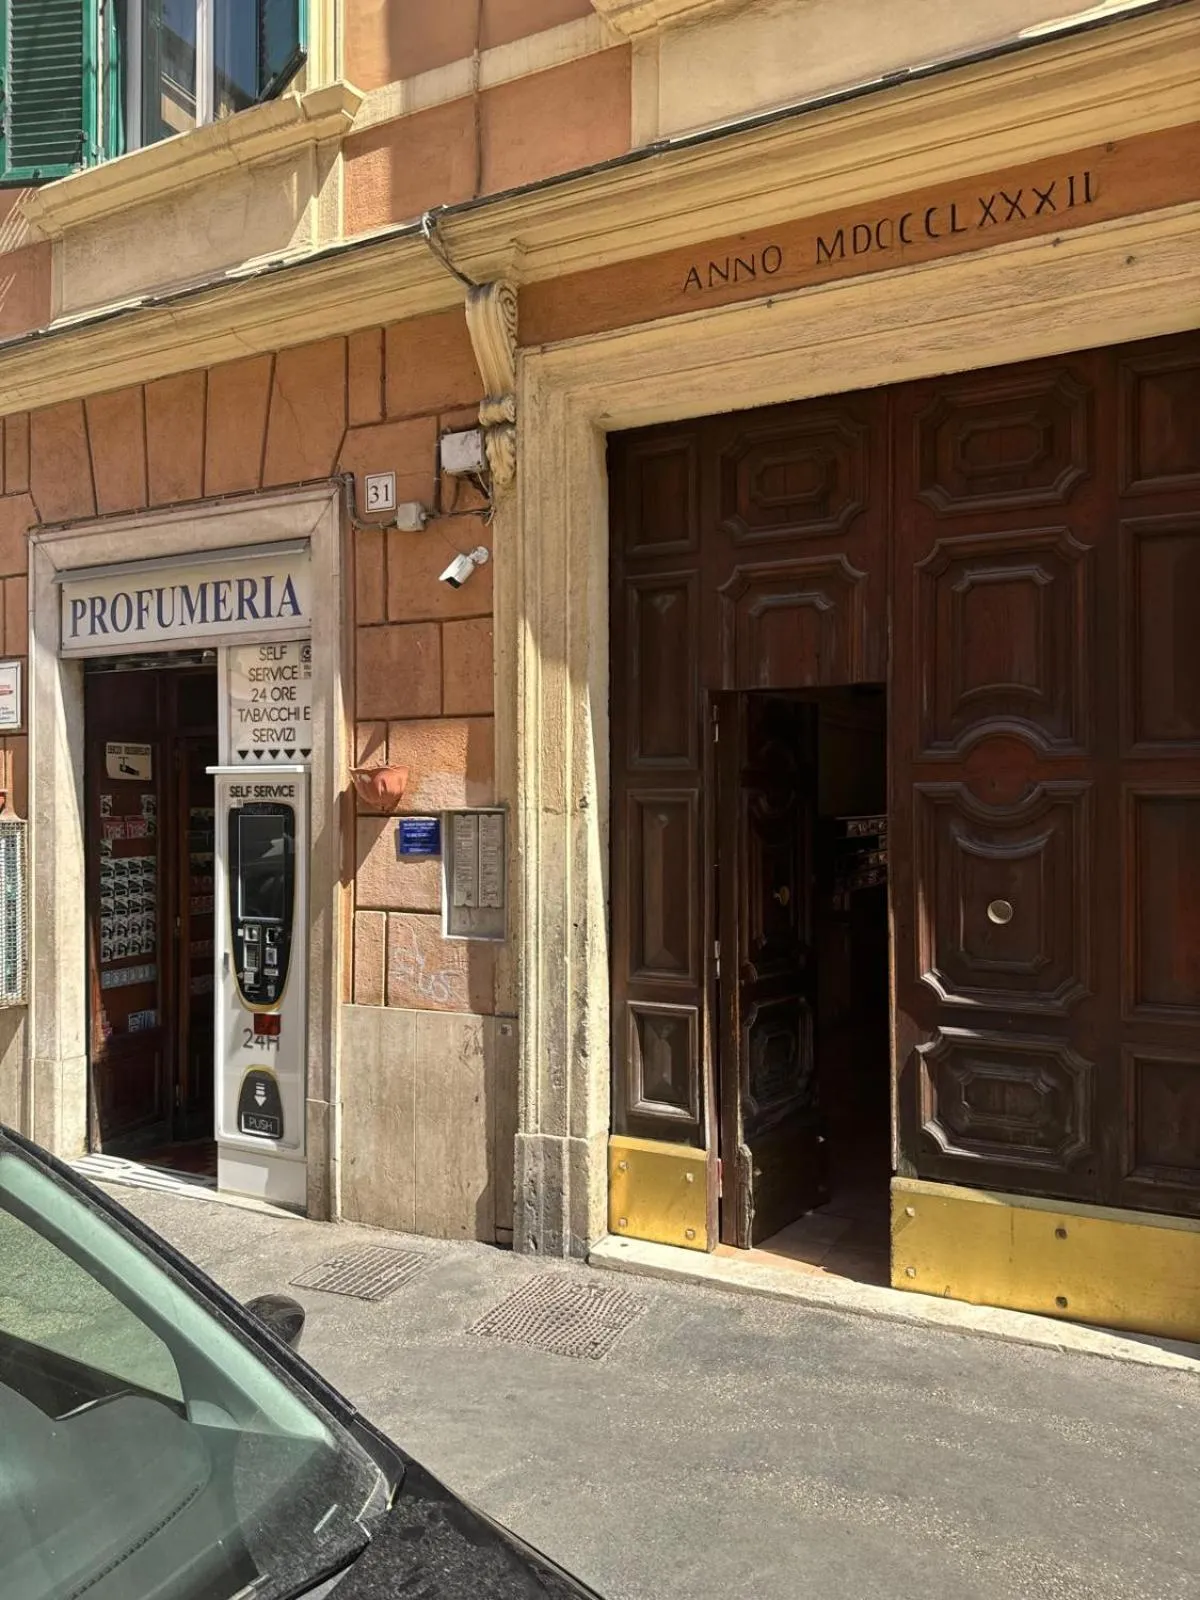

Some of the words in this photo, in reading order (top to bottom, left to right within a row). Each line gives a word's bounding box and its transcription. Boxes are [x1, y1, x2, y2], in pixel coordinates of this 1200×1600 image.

[682, 244, 783, 294] ANNO
[815, 171, 1092, 265] MDCCCLXXXII
[368, 483, 390, 504] 31
[69, 573, 302, 638] PROFUMERIA
[259, 645, 287, 661] SELF
[248, 665, 298, 682] SERVICE
[251, 688, 267, 702] 24
[270, 686, 296, 701] ORE
[237, 706, 300, 722] TABACCHI
[303, 706, 311, 721] E
[252, 727, 296, 742] SERVIZI
[229, 785, 252, 798] SELF
[253, 784, 295, 798] SERVICE
[242, 1027, 280, 1052] 24H
[249, 1116, 273, 1132] PUSH
